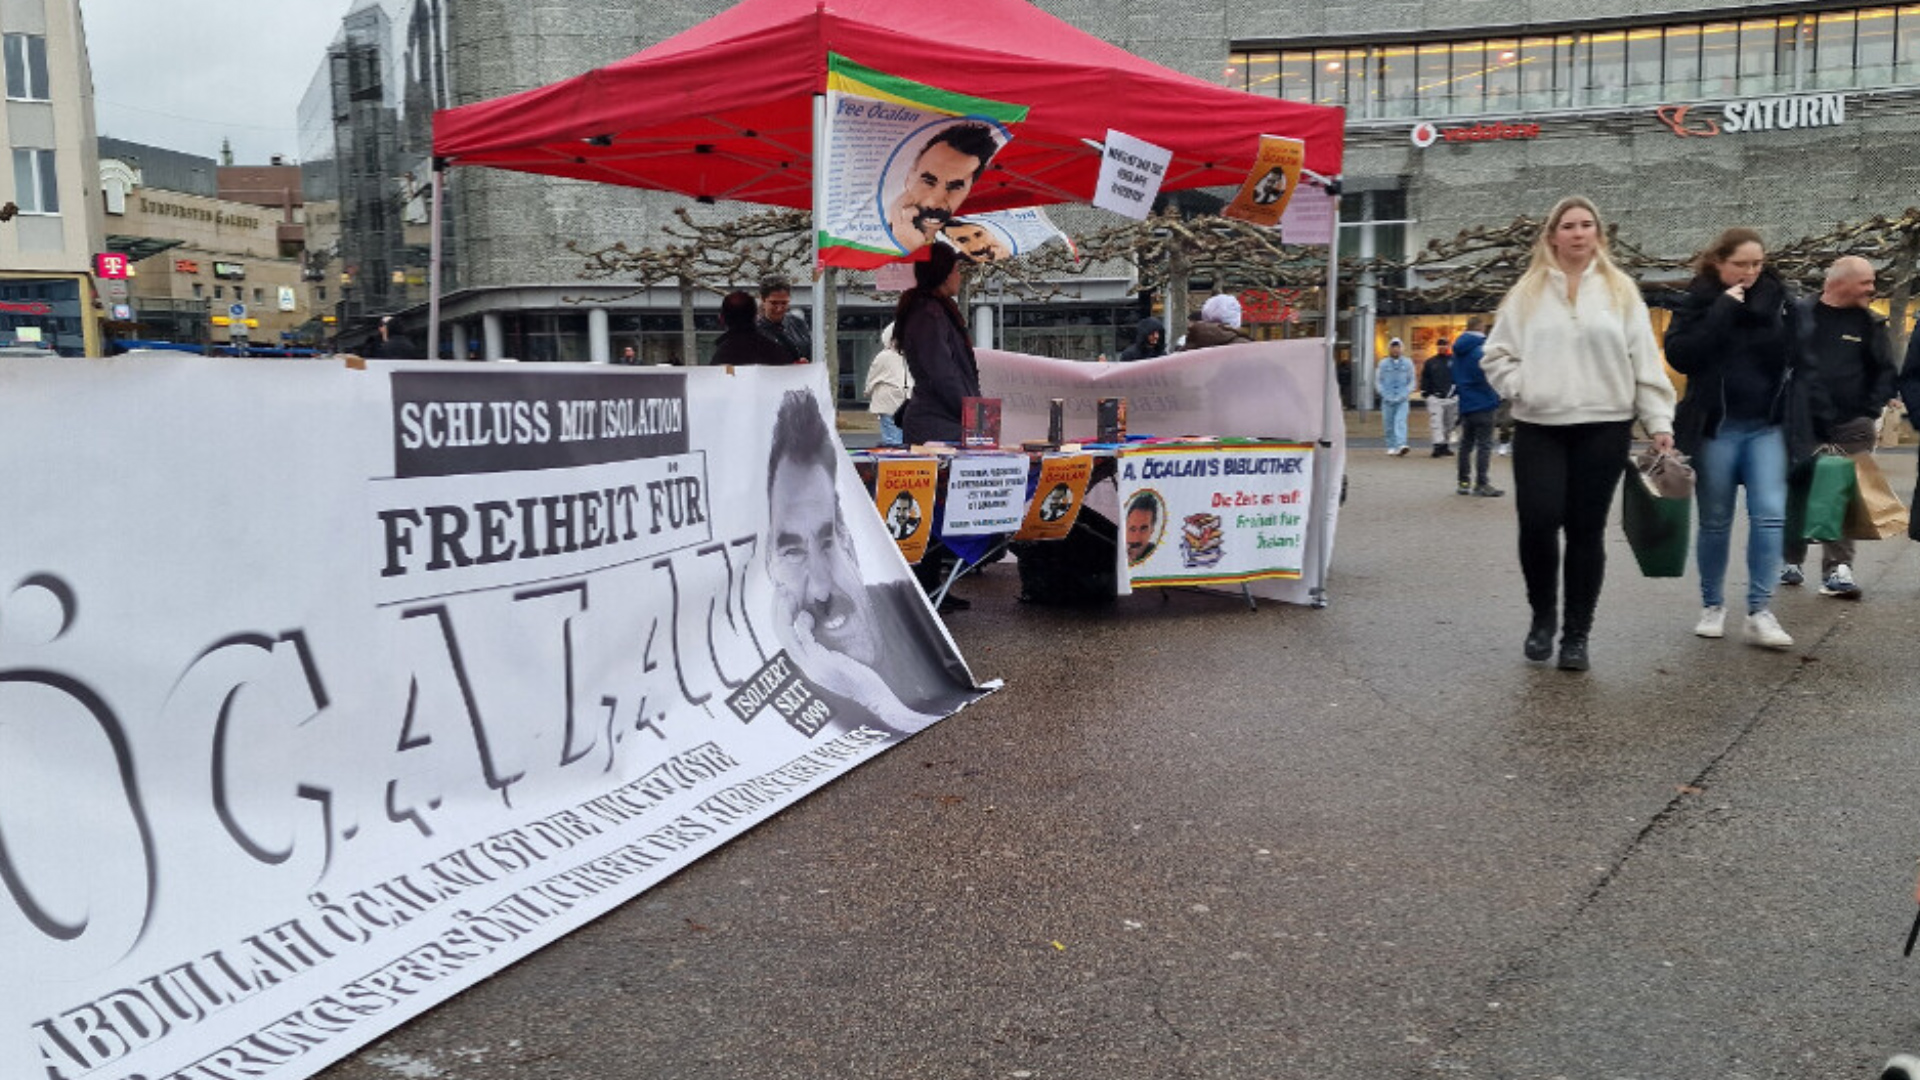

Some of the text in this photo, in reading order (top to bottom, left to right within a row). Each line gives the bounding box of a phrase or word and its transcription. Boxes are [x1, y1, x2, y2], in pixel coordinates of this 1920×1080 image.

[1442, 120, 1541, 142] vodafone
[1722, 95, 1846, 134] SATURN
[401, 398, 683, 449] SCHLUSS MIT ISOLATION
[1123, 456, 1303, 481] A. ÖCALAN'S BIBLIOTHEK
[377, 461, 707, 578] FREIHEIT FÜR
[733, 657, 791, 718] ISOLIERT
[775, 679, 812, 715] SEIT
[796, 699, 830, 733] 1999
[637, 814, 717, 852] DES
[31, 741, 740, 1080] ABDULLAH ÖCALAN IST DIE WICHTIGSTE
